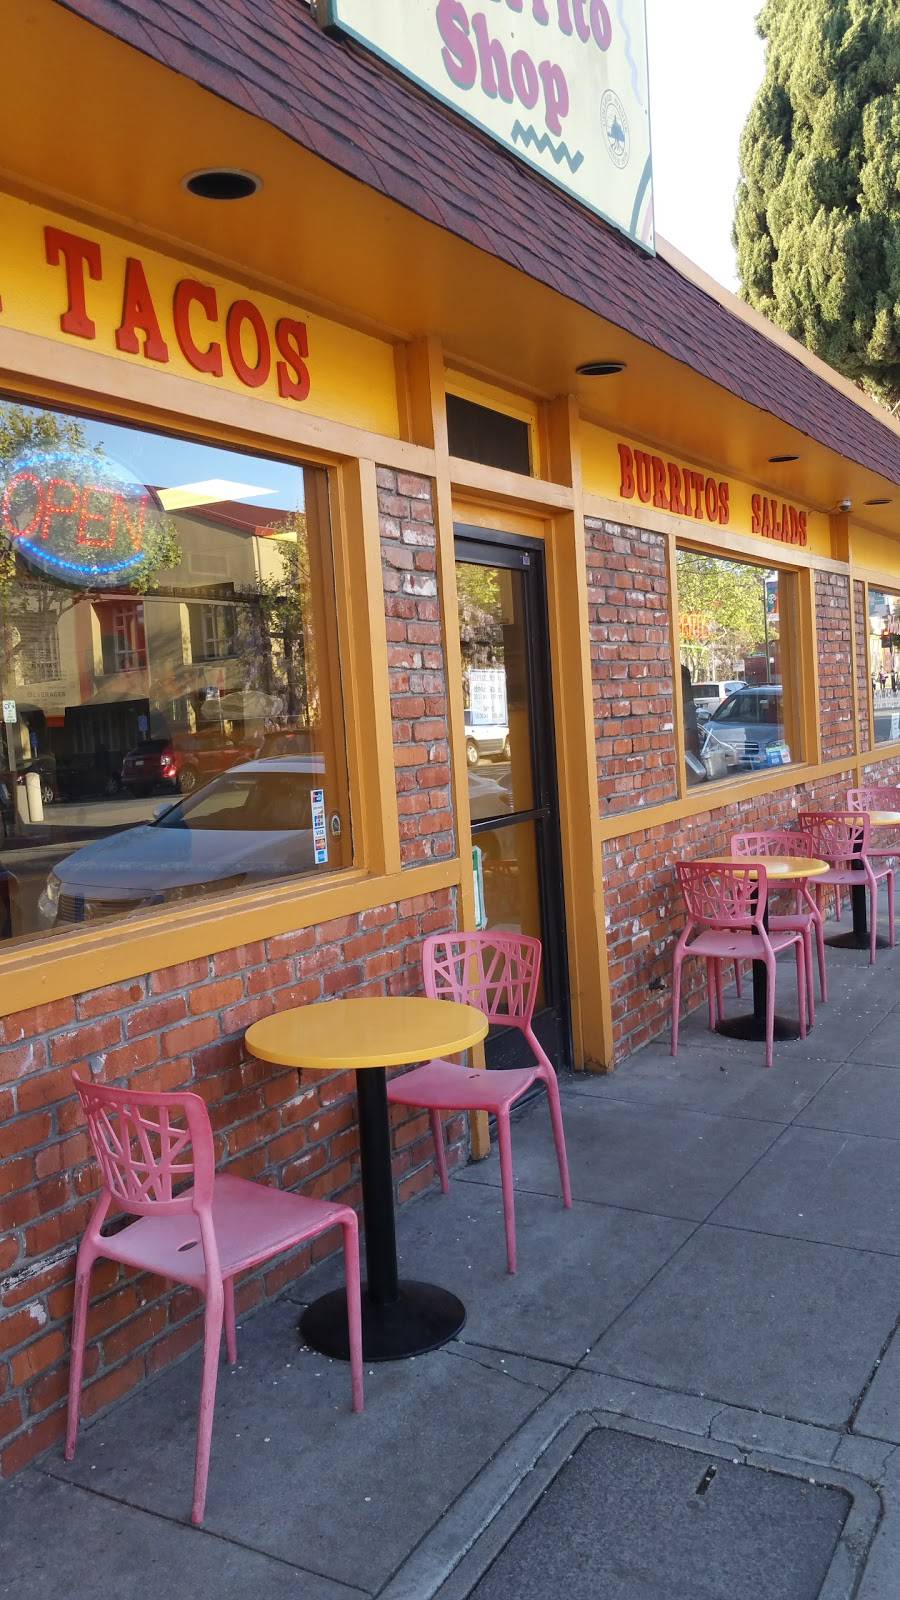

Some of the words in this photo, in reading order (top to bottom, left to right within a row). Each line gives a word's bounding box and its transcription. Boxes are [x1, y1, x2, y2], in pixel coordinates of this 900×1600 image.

[436, 0, 569, 137] Shop
[44, 226, 311, 402] TACOS
[2, 472, 149, 553] OPEN
[617, 443, 730, 525] BURRITOS
[751, 493, 808, 547] SALADS
